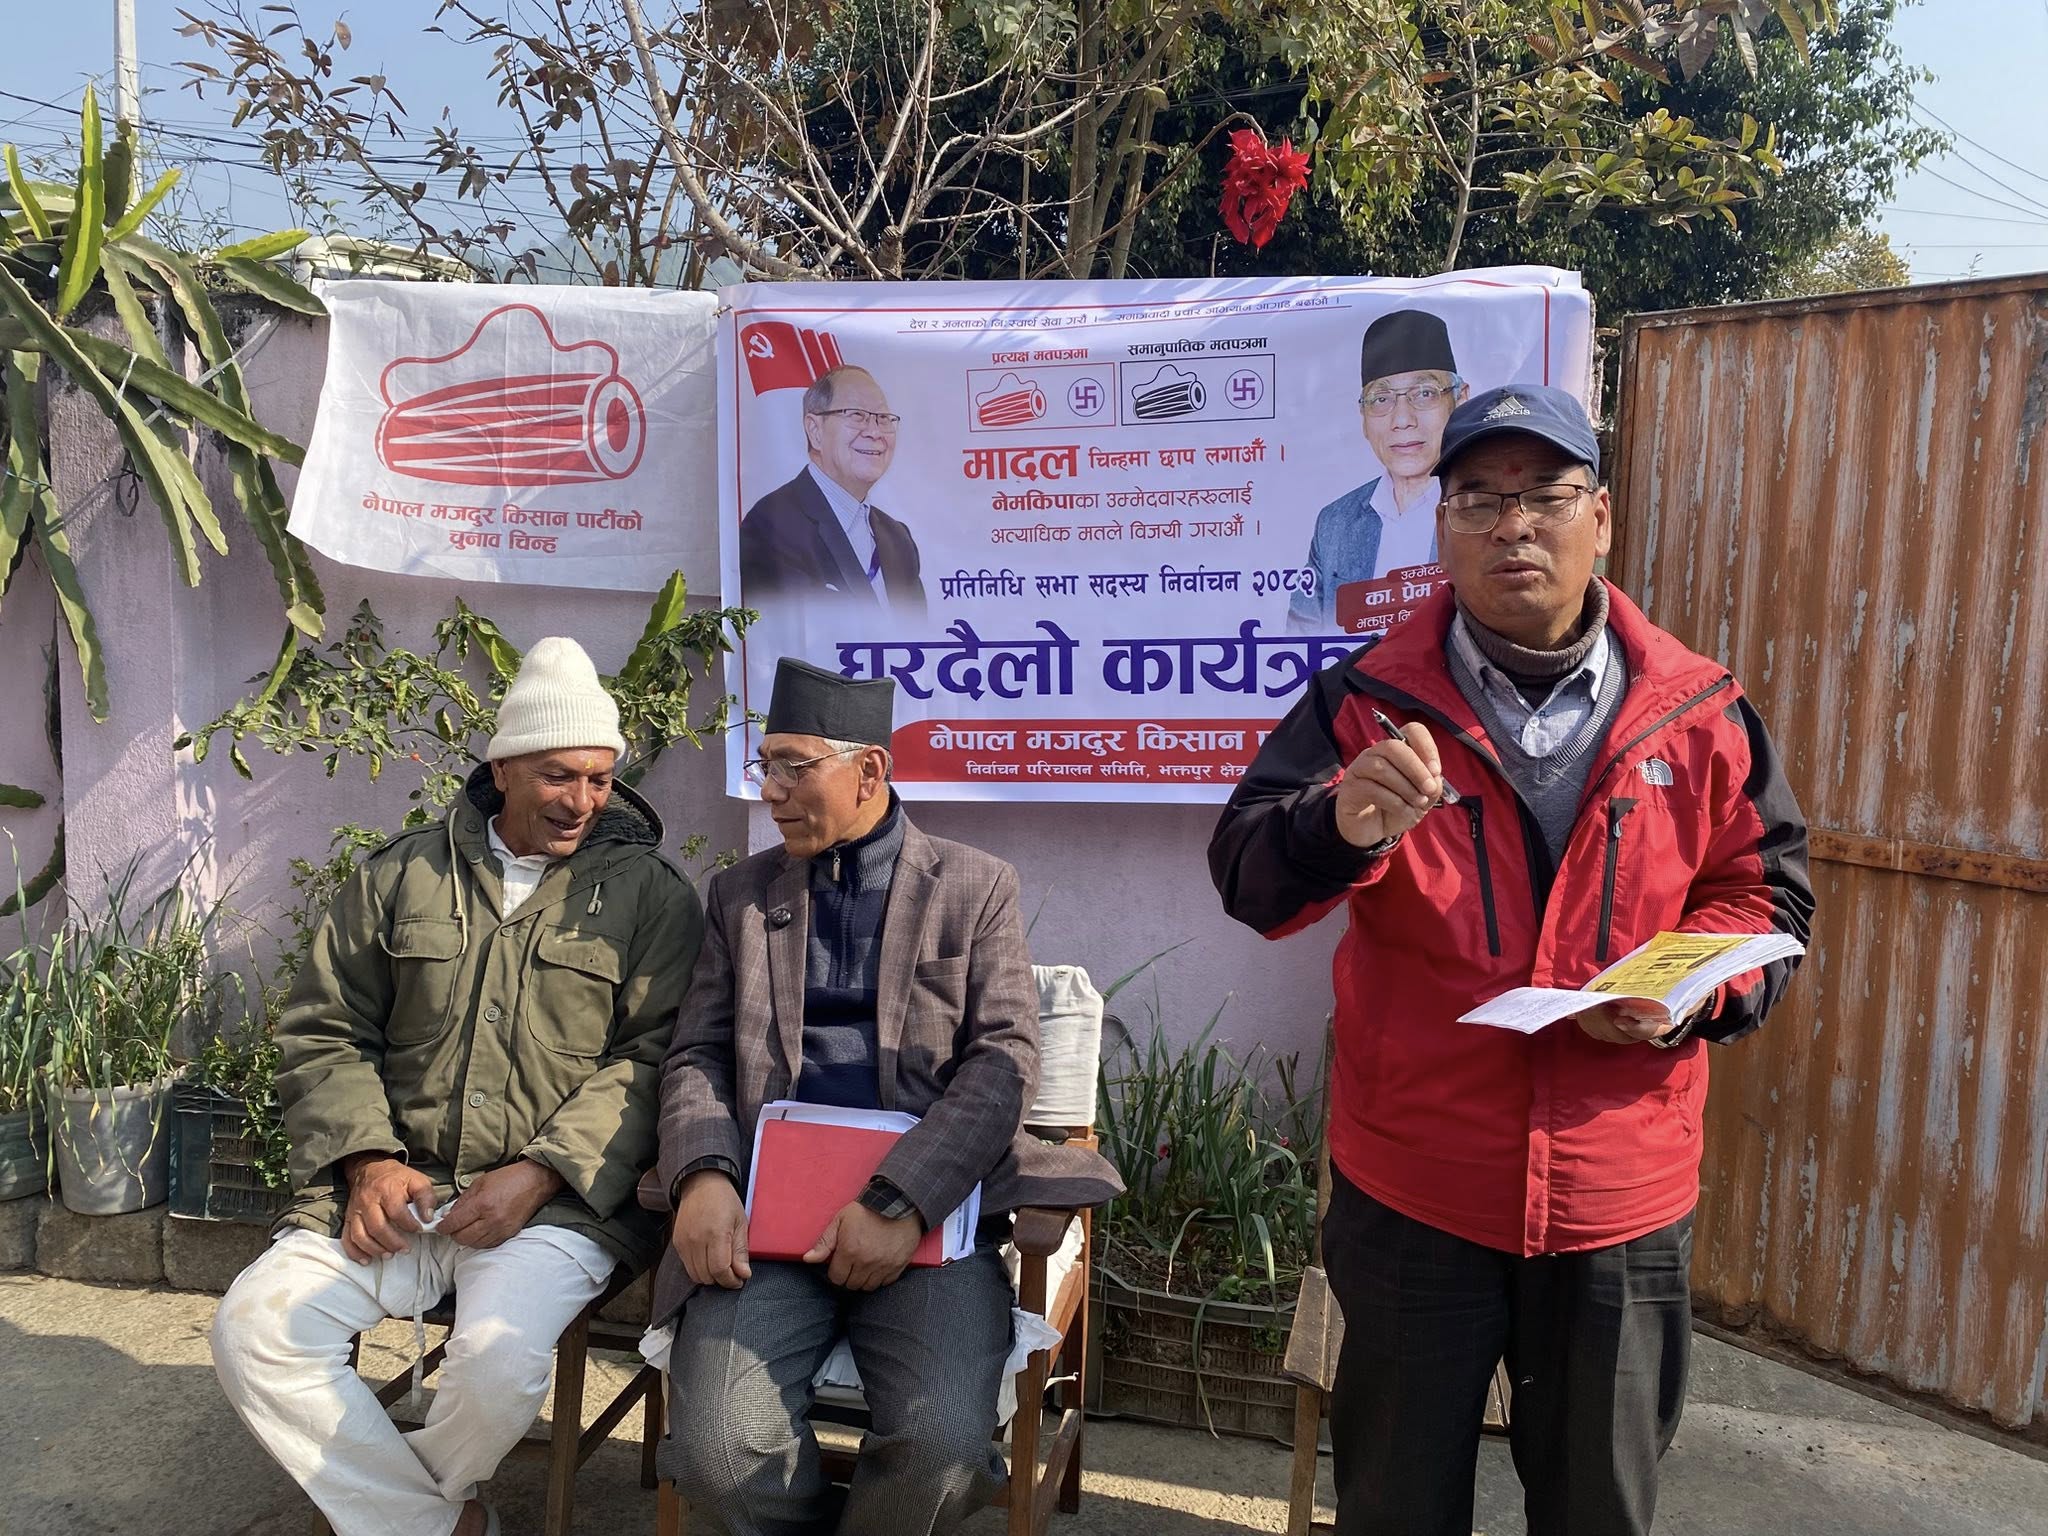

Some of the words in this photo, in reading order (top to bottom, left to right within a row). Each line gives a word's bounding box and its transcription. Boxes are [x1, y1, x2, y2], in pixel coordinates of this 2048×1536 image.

[909, 317, 928, 329] देश
[931, 320, 939, 329] र
[942, 317, 987, 329] जनताको
[1041, 315, 1062, 327] सेवा
[992, 350, 1029, 365] प्रत्यक्ष
[1033, 348, 1089, 361] मतपत्रमा
[1127, 338, 1205, 357] समानुपातिक
[1210, 337, 1268, 351] मतपत्रमा
[1482, 407, 1531, 422] adidas
[962, 444, 1081, 482] मादल
[1088, 446, 1150, 472] चिन्हमा
[1158, 449, 1196, 468] छाप
[362, 491, 424, 518] नेपाल
[430, 503, 497, 527] मजदुर
[502, 503, 570, 527] किसान
[575, 508, 644, 531] पार्टीको
[991, 489, 1099, 512] नेमकिपाका
[449, 529, 501, 550] चुनाव
[508, 528, 559, 554] चिन्ह
[991, 523, 1072, 544] अत्याधिक
[1077, 519, 1124, 540] मतले
[1129, 518, 1183, 539] विजयी
[940, 568, 1026, 600] प्रतिनिधि
[1035, 575, 1079, 598] सभा
[1088, 573, 1149, 599] सदस्य
[1159, 564, 1241, 595] निर्वाचन
[1252, 568, 1318, 599] २०८२
[1401, 581, 1433, 603] प्रेम
[836, 619, 1080, 701] घरदैलो
[1102, 619, 1386, 698] कार्यक्र
[929, 724, 1017, 751] नेपाल
[1026, 730, 1128, 757] मजदुर
[1137, 723, 1246, 753] किसान
[965, 760, 1020, 776] निर्वाचन
[1026, 760, 1093, 777] परिचालन
[1099, 760, 1150, 779] समिति,
[1158, 765, 1213, 780] भक्तपुर
[1220, 762, 1248, 778] क्षेत्र
